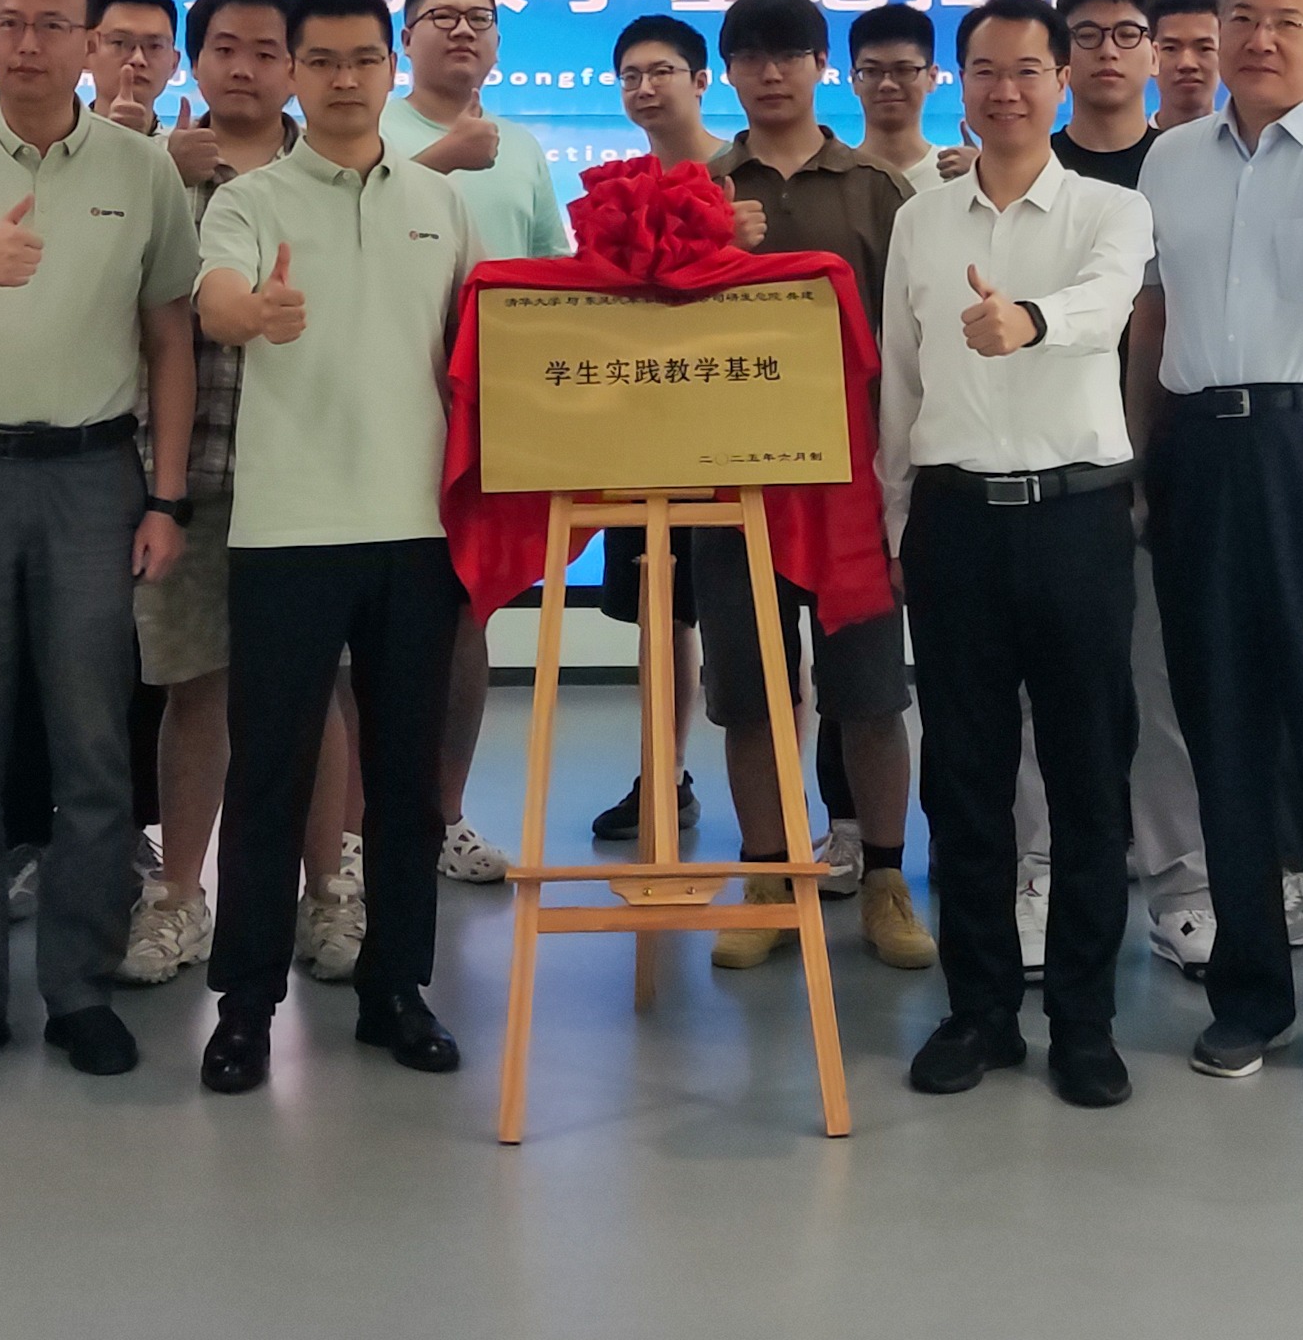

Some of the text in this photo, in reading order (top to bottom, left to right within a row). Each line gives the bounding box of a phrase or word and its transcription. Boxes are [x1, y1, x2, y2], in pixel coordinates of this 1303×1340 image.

[484, 66, 617, 89] Dongfe
[544, 357, 782, 388] 学生实践教学基地
